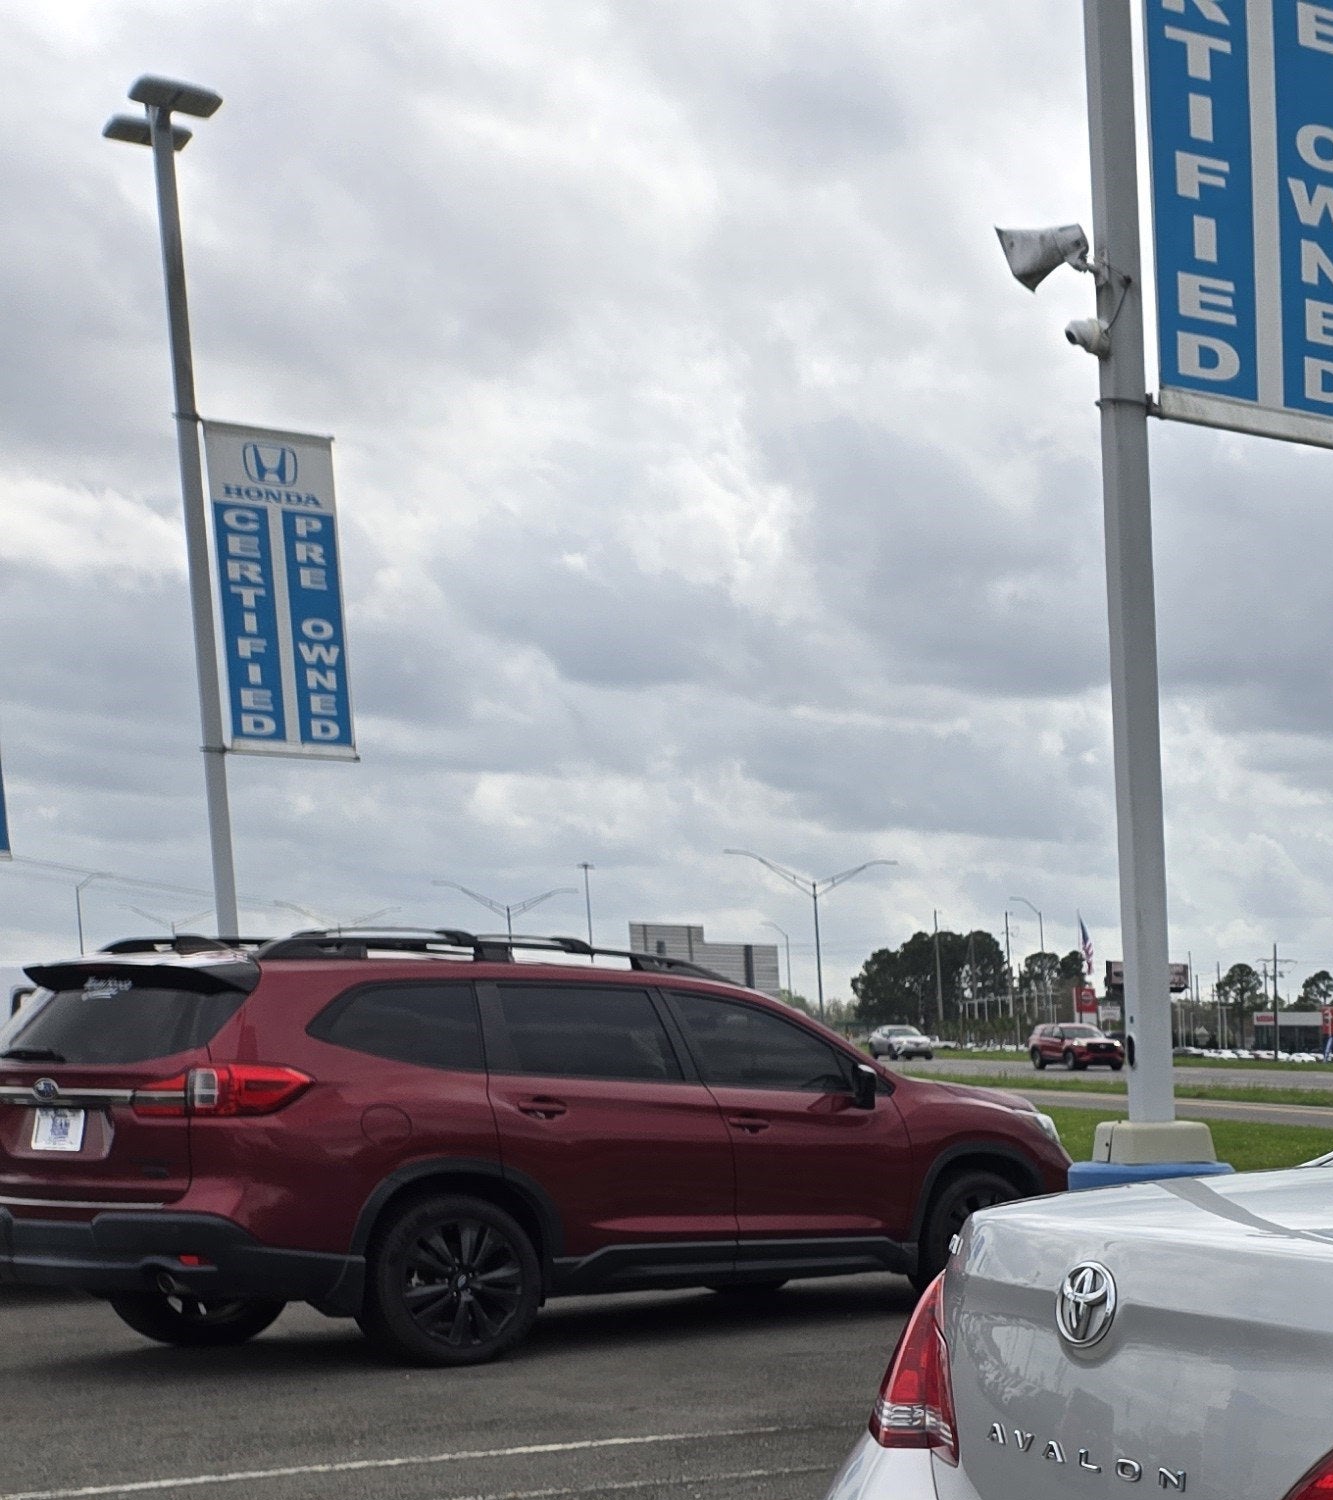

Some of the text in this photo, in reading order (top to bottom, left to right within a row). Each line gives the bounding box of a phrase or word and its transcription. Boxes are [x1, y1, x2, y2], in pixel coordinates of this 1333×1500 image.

[222, 482, 322, 507] HONDA
[222, 508, 277, 737] CERTIFIED
[294, 516, 340, 742] PRE OWNED
[986, 1421, 1188, 1493] AVALON
